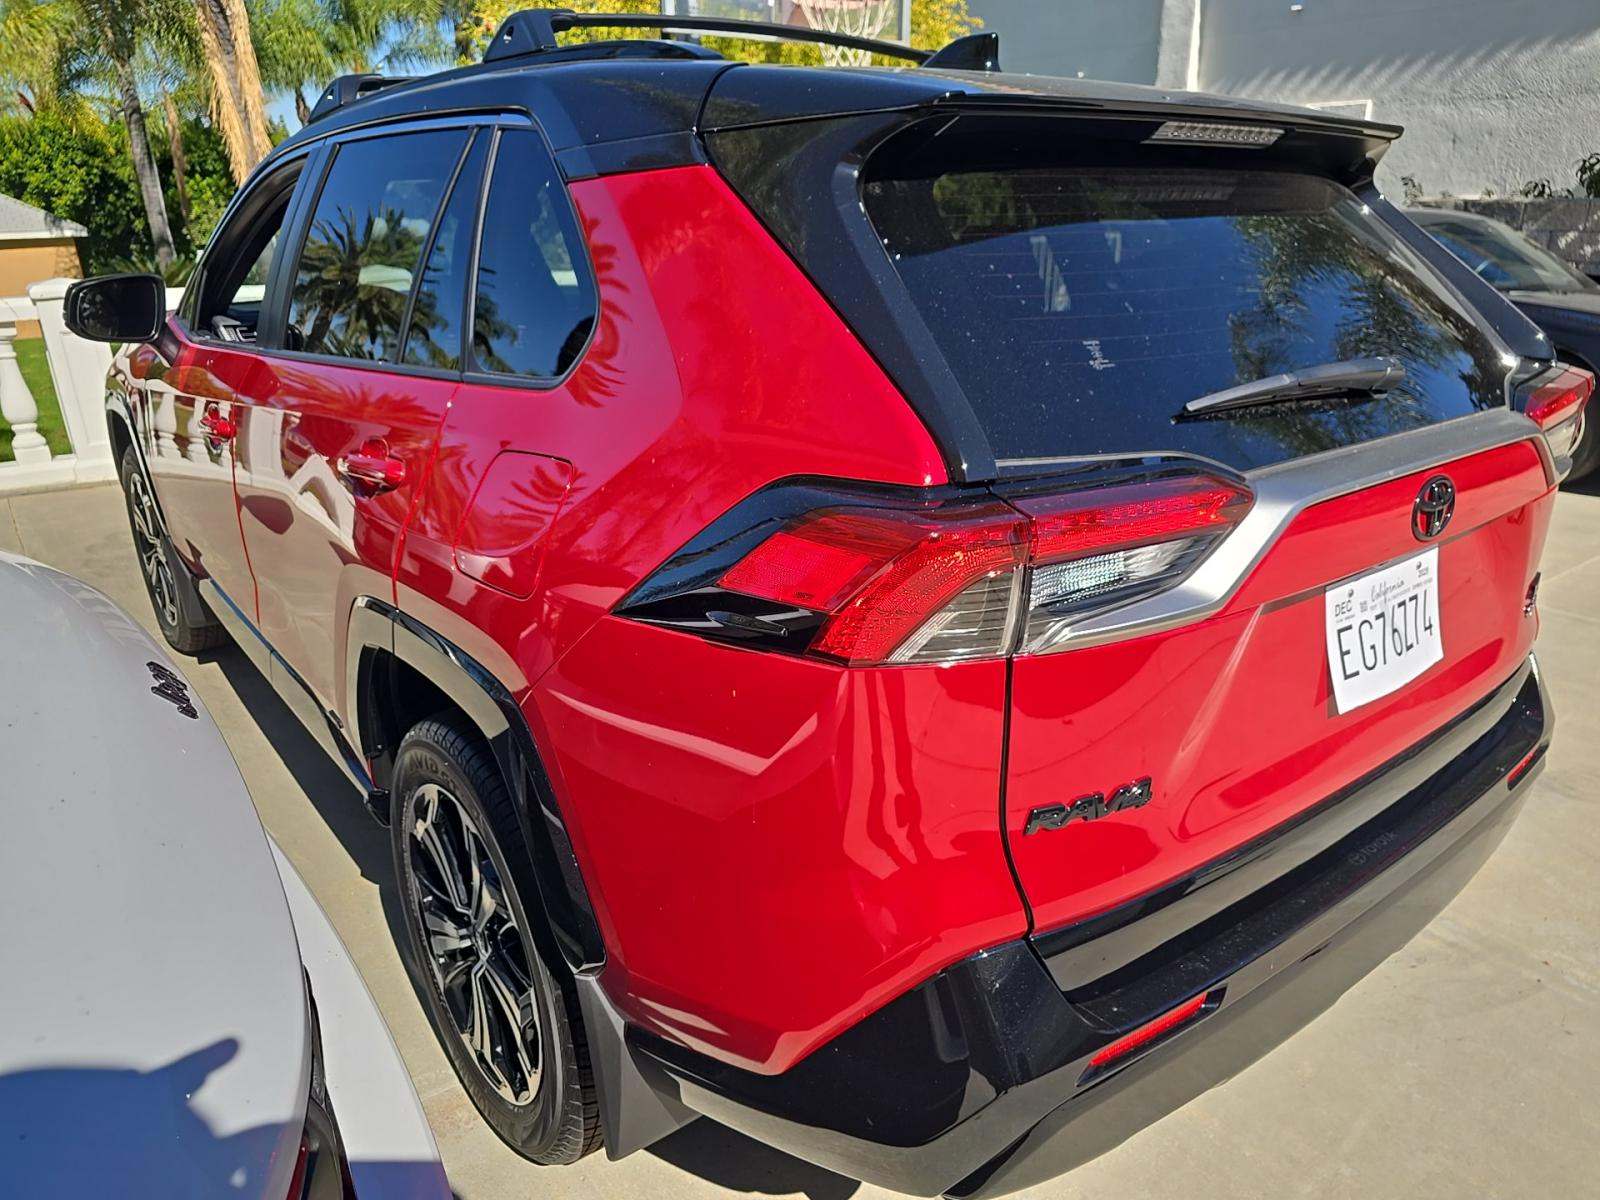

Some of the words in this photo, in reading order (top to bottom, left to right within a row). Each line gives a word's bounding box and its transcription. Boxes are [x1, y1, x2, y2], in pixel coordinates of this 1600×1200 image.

[1334, 599, 1353, 618] DEC
[1371, 580, 1405, 604] California
[1337, 589, 1433, 681] EG76Z74
[1023, 775, 1153, 836] RAV4
